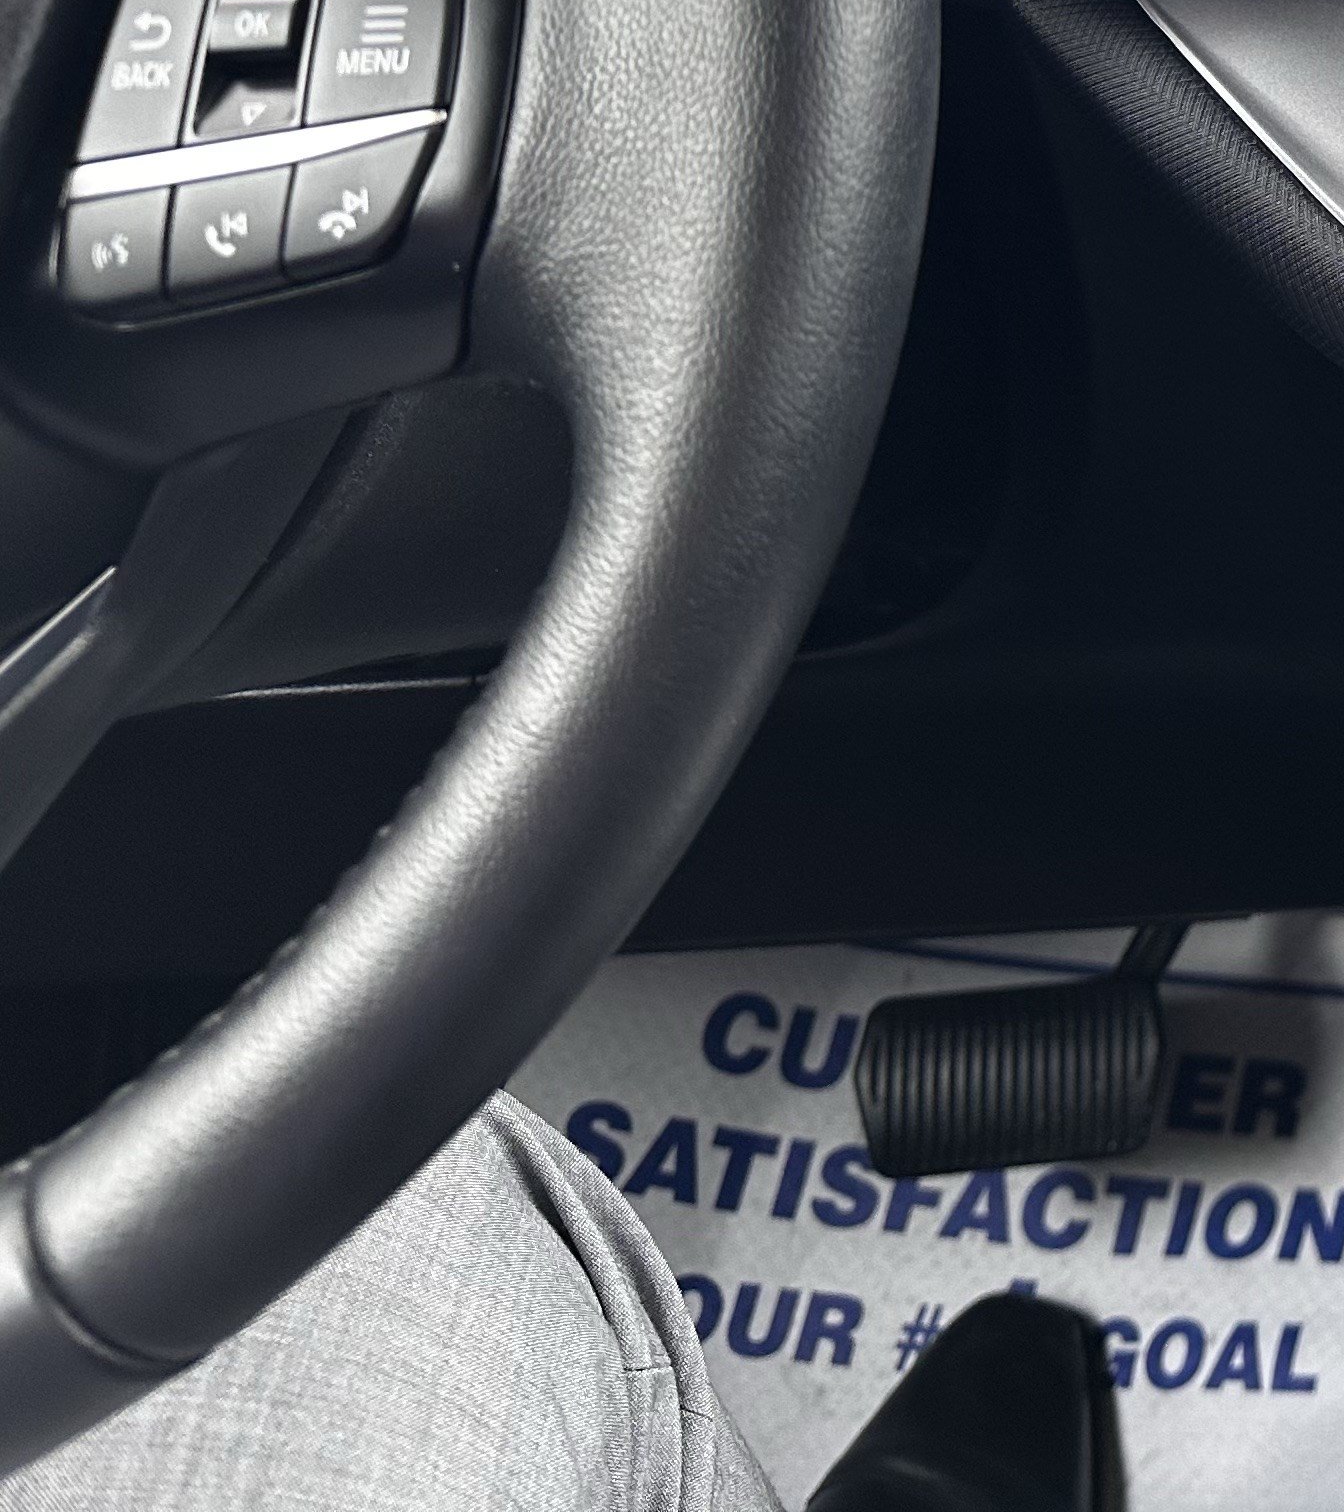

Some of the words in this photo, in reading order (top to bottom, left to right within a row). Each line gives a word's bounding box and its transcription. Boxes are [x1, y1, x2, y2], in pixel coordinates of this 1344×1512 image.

[234, 9, 272, 38] OK
[111, 60, 174, 91] BACK
[336, 46, 411, 77] MENU
[1102, 1315, 1319, 1394] GOAL
